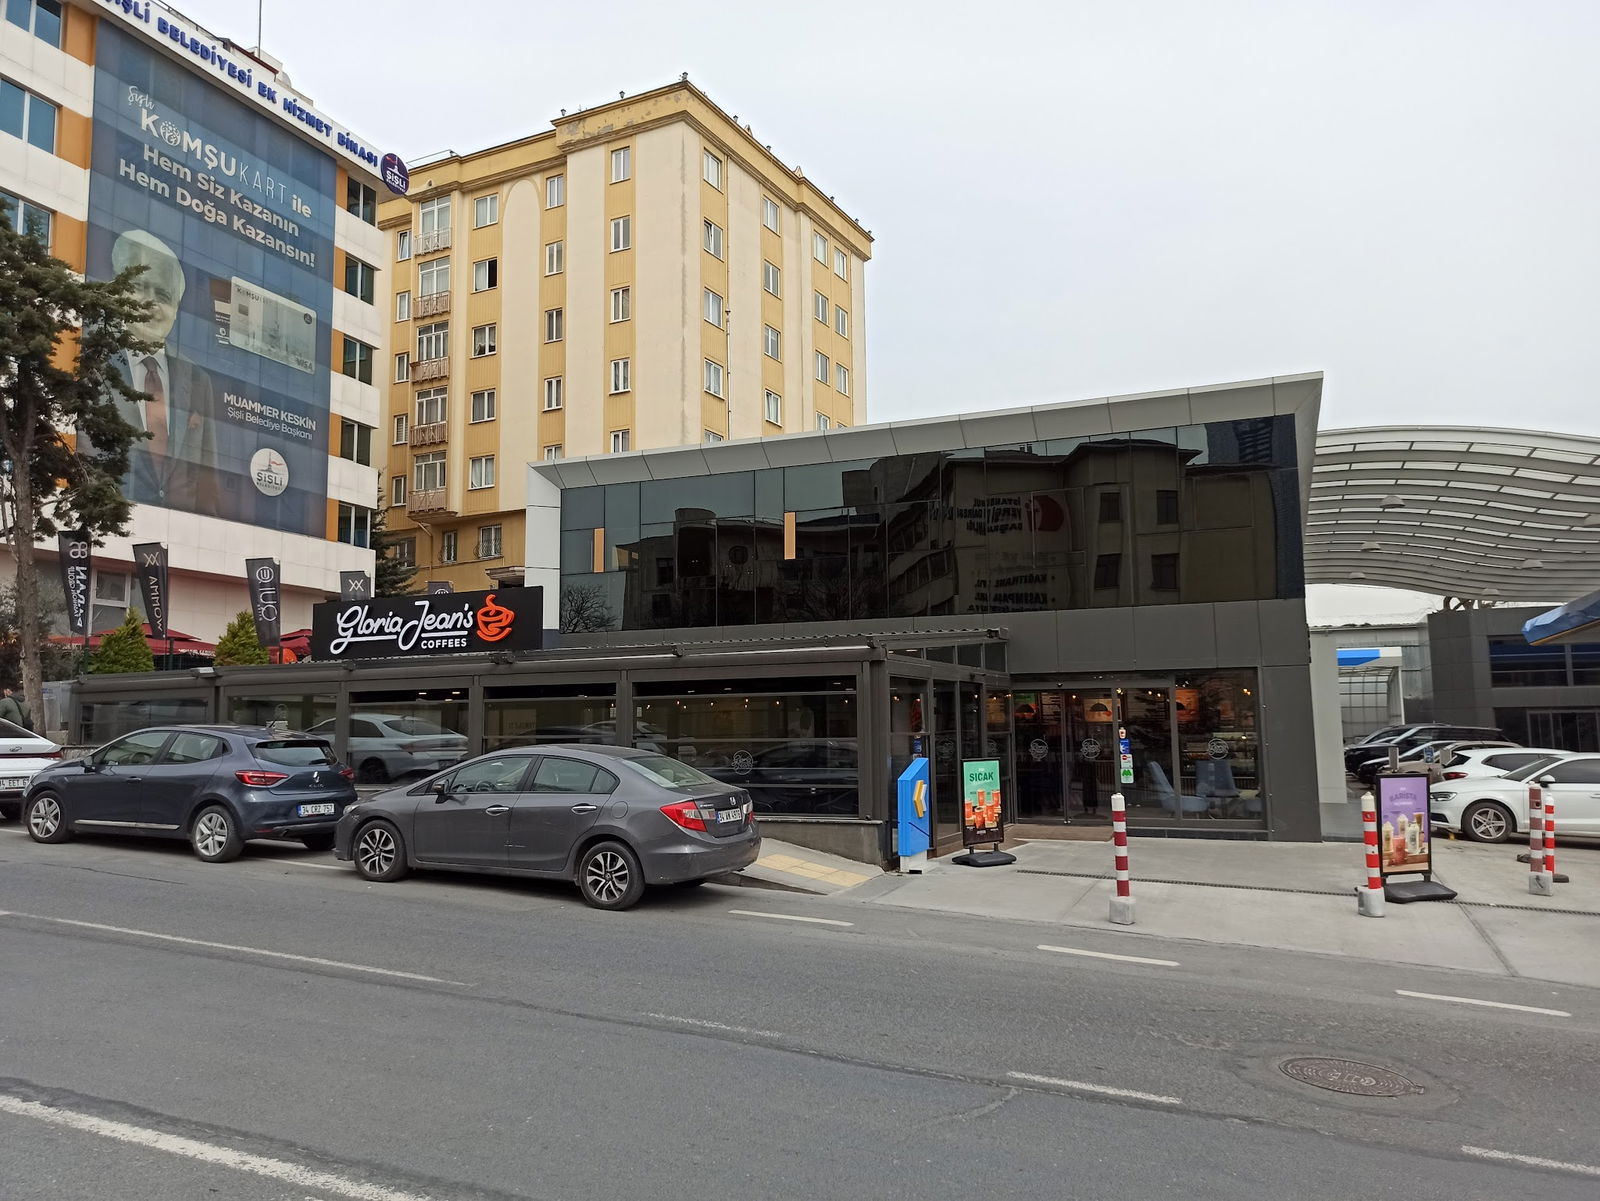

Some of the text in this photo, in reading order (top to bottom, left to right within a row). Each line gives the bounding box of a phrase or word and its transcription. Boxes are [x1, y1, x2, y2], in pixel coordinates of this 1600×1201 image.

[104, 0, 378, 167] ŞLİ BELEDİYESİ EK HİZMET BİNASI
[143, 144, 299, 237] Hem Siz Kazanın
[291, 193, 312, 218] ile
[119, 159, 316, 268] Hem Doğa Kazansın!
[223, 392, 316, 431] MUAMMER KESKİN
[245, 412, 280, 430] Belediye
[281, 423, 313, 440] Başkanı
[330, 600, 474, 655] Gloria Jean's
[421, 638, 467, 649] COFFEES
[969, 771, 994, 782] SICAK
[301, 806, 309, 814] 34
